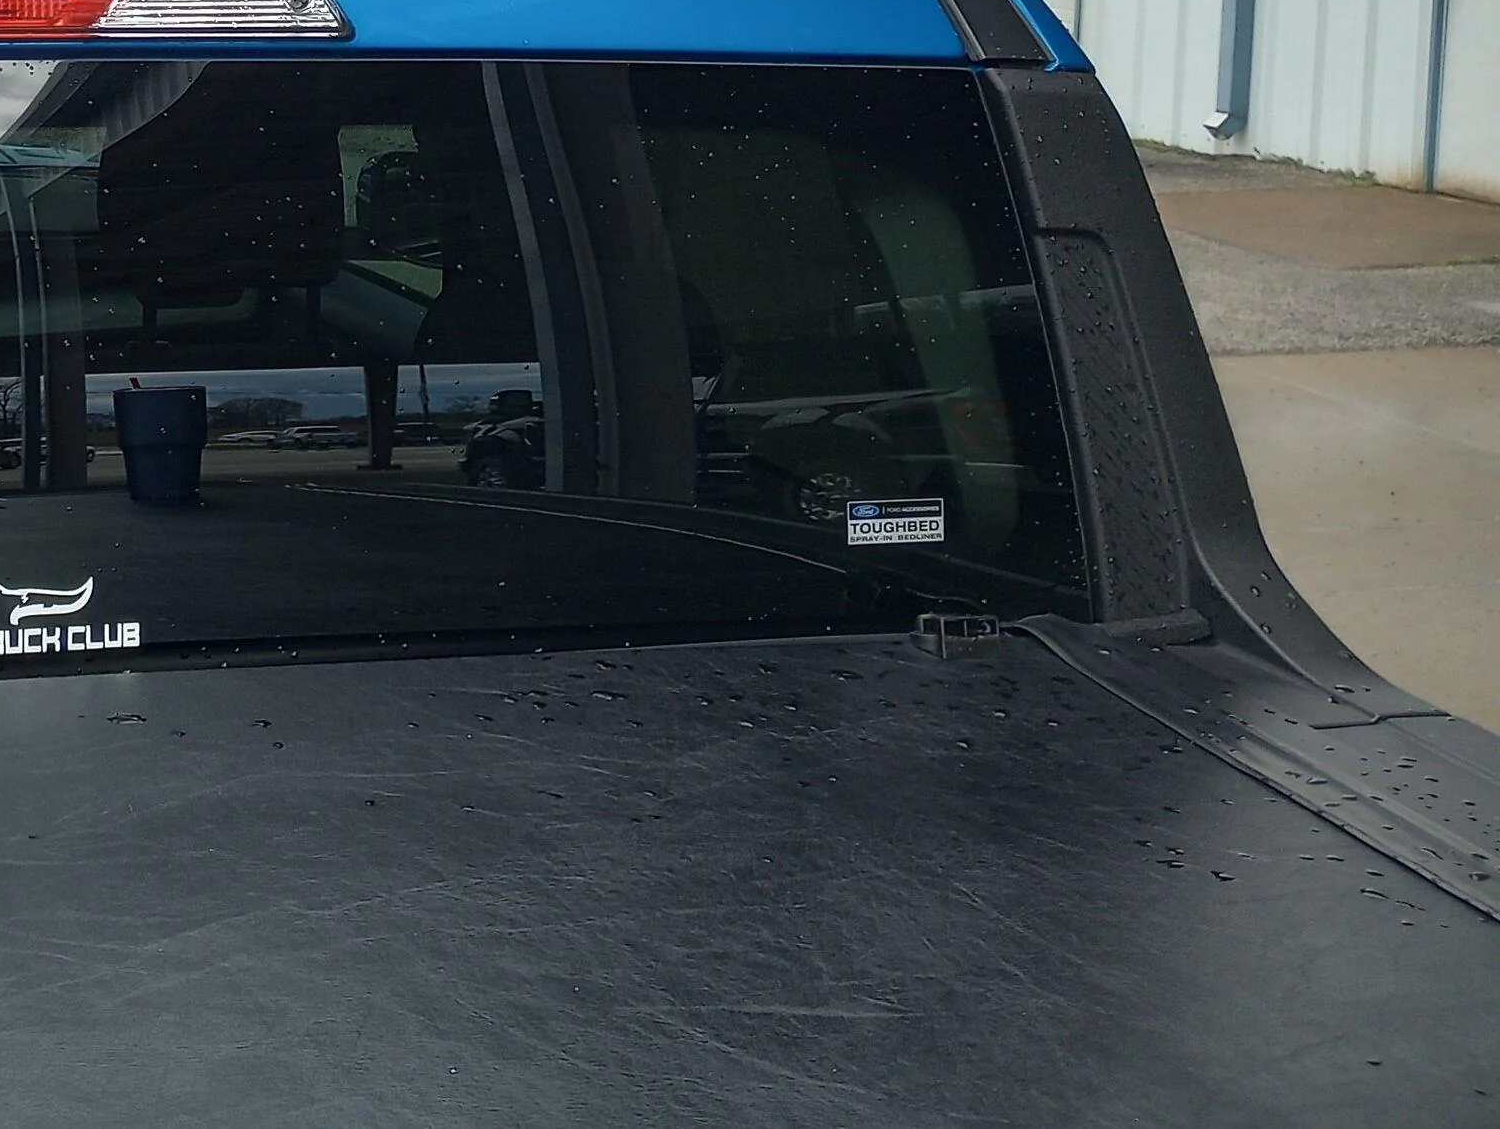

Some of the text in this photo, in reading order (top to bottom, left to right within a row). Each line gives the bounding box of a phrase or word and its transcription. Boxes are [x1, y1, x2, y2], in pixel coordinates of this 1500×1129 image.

[850, 520, 940, 534] TOUGHBED
[850, 533, 943, 543] SPRAY-IN BEDLINER
[67, 622, 141, 651] CLUB
